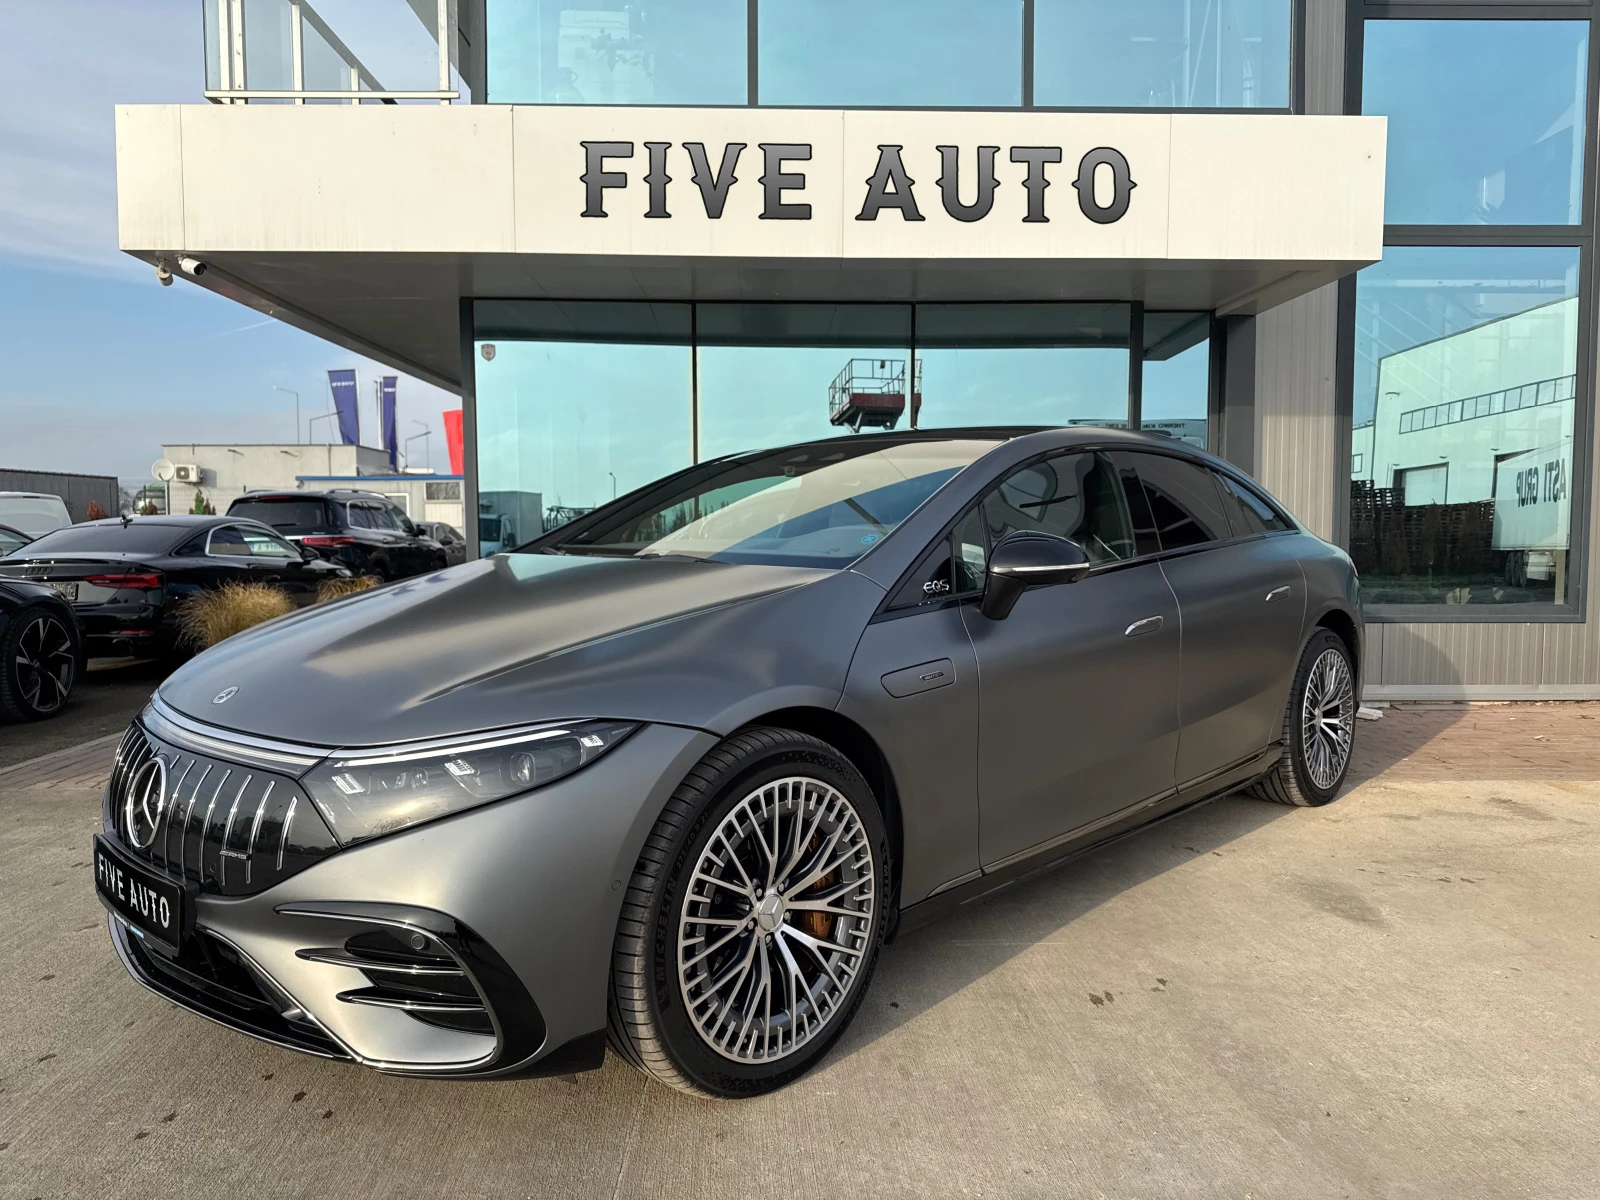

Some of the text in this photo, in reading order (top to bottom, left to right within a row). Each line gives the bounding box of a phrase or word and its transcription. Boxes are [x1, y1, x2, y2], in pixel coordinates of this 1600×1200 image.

[579, 140, 1138, 225] FIVE AUTO
[923, 579, 950, 593] EQS
[98, 851, 171, 929] FIVE AUTO
[655, 876, 679, 983] MICHELIN
